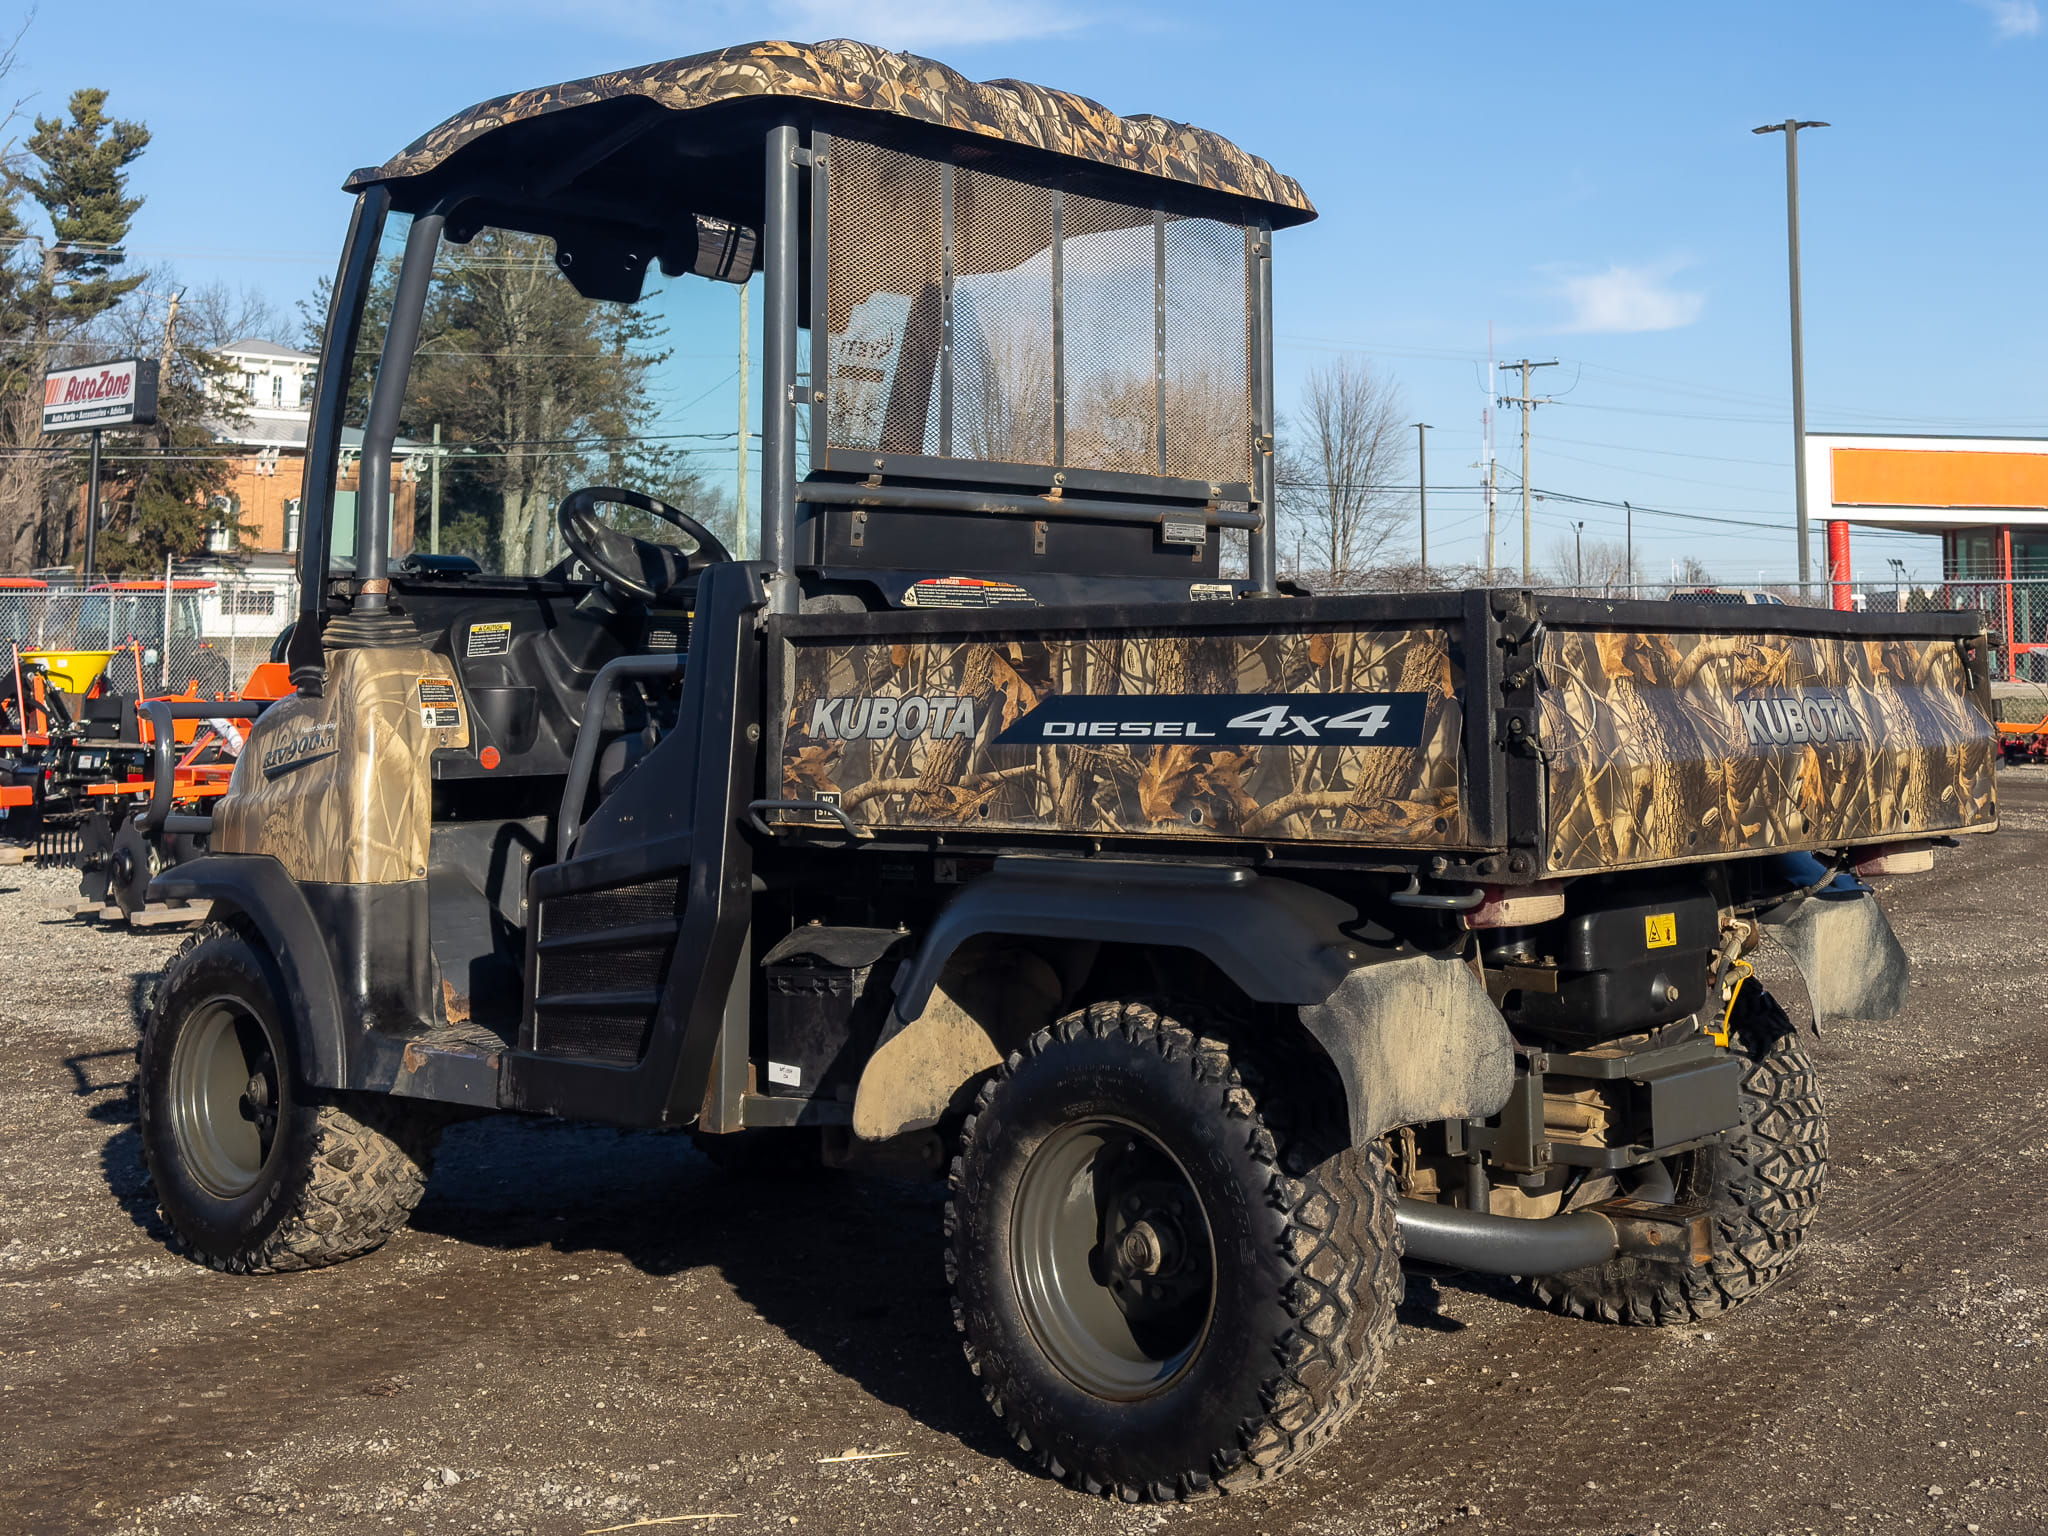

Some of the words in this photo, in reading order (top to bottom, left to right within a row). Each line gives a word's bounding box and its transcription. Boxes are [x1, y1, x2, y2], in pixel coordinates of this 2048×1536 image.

[64, 370, 130, 402] AutoZone
[809, 696, 976, 740] KUBOTA
[1042, 721, 1216, 737] DIESEL
[1226, 705, 1391, 737] 4x4
[1737, 696, 1862, 745] KUBOTA
[822, 795, 834, 804] NO
